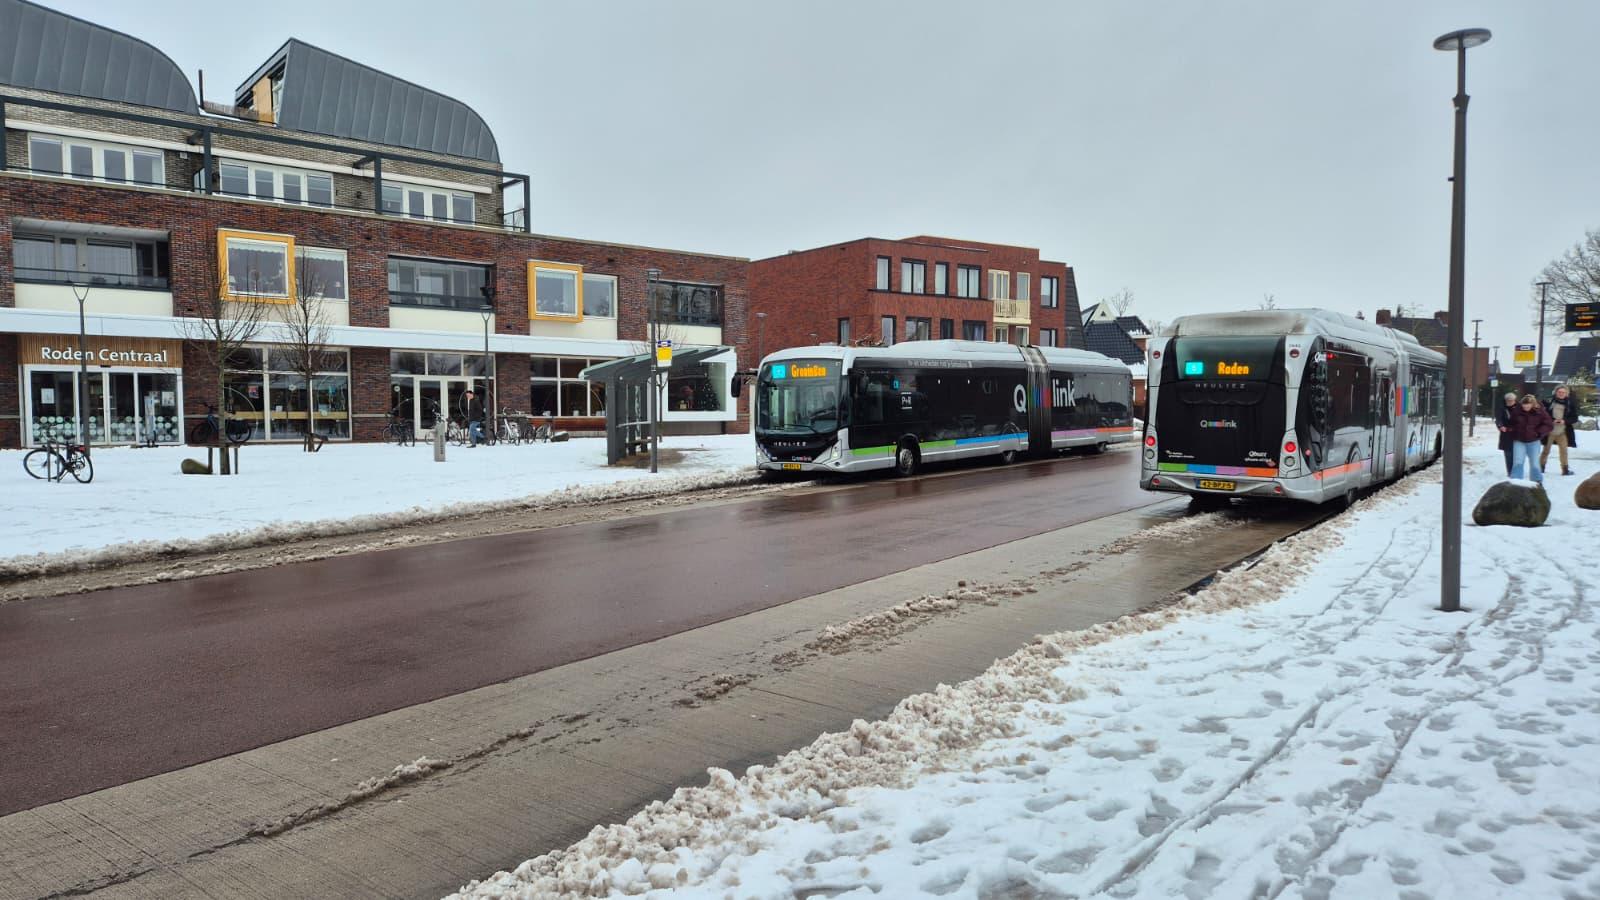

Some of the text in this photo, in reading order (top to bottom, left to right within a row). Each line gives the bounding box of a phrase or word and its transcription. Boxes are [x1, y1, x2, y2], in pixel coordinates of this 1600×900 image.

[41, 346, 168, 363] Roden Centraal
[1217, 361, 1249, 375] Roden
